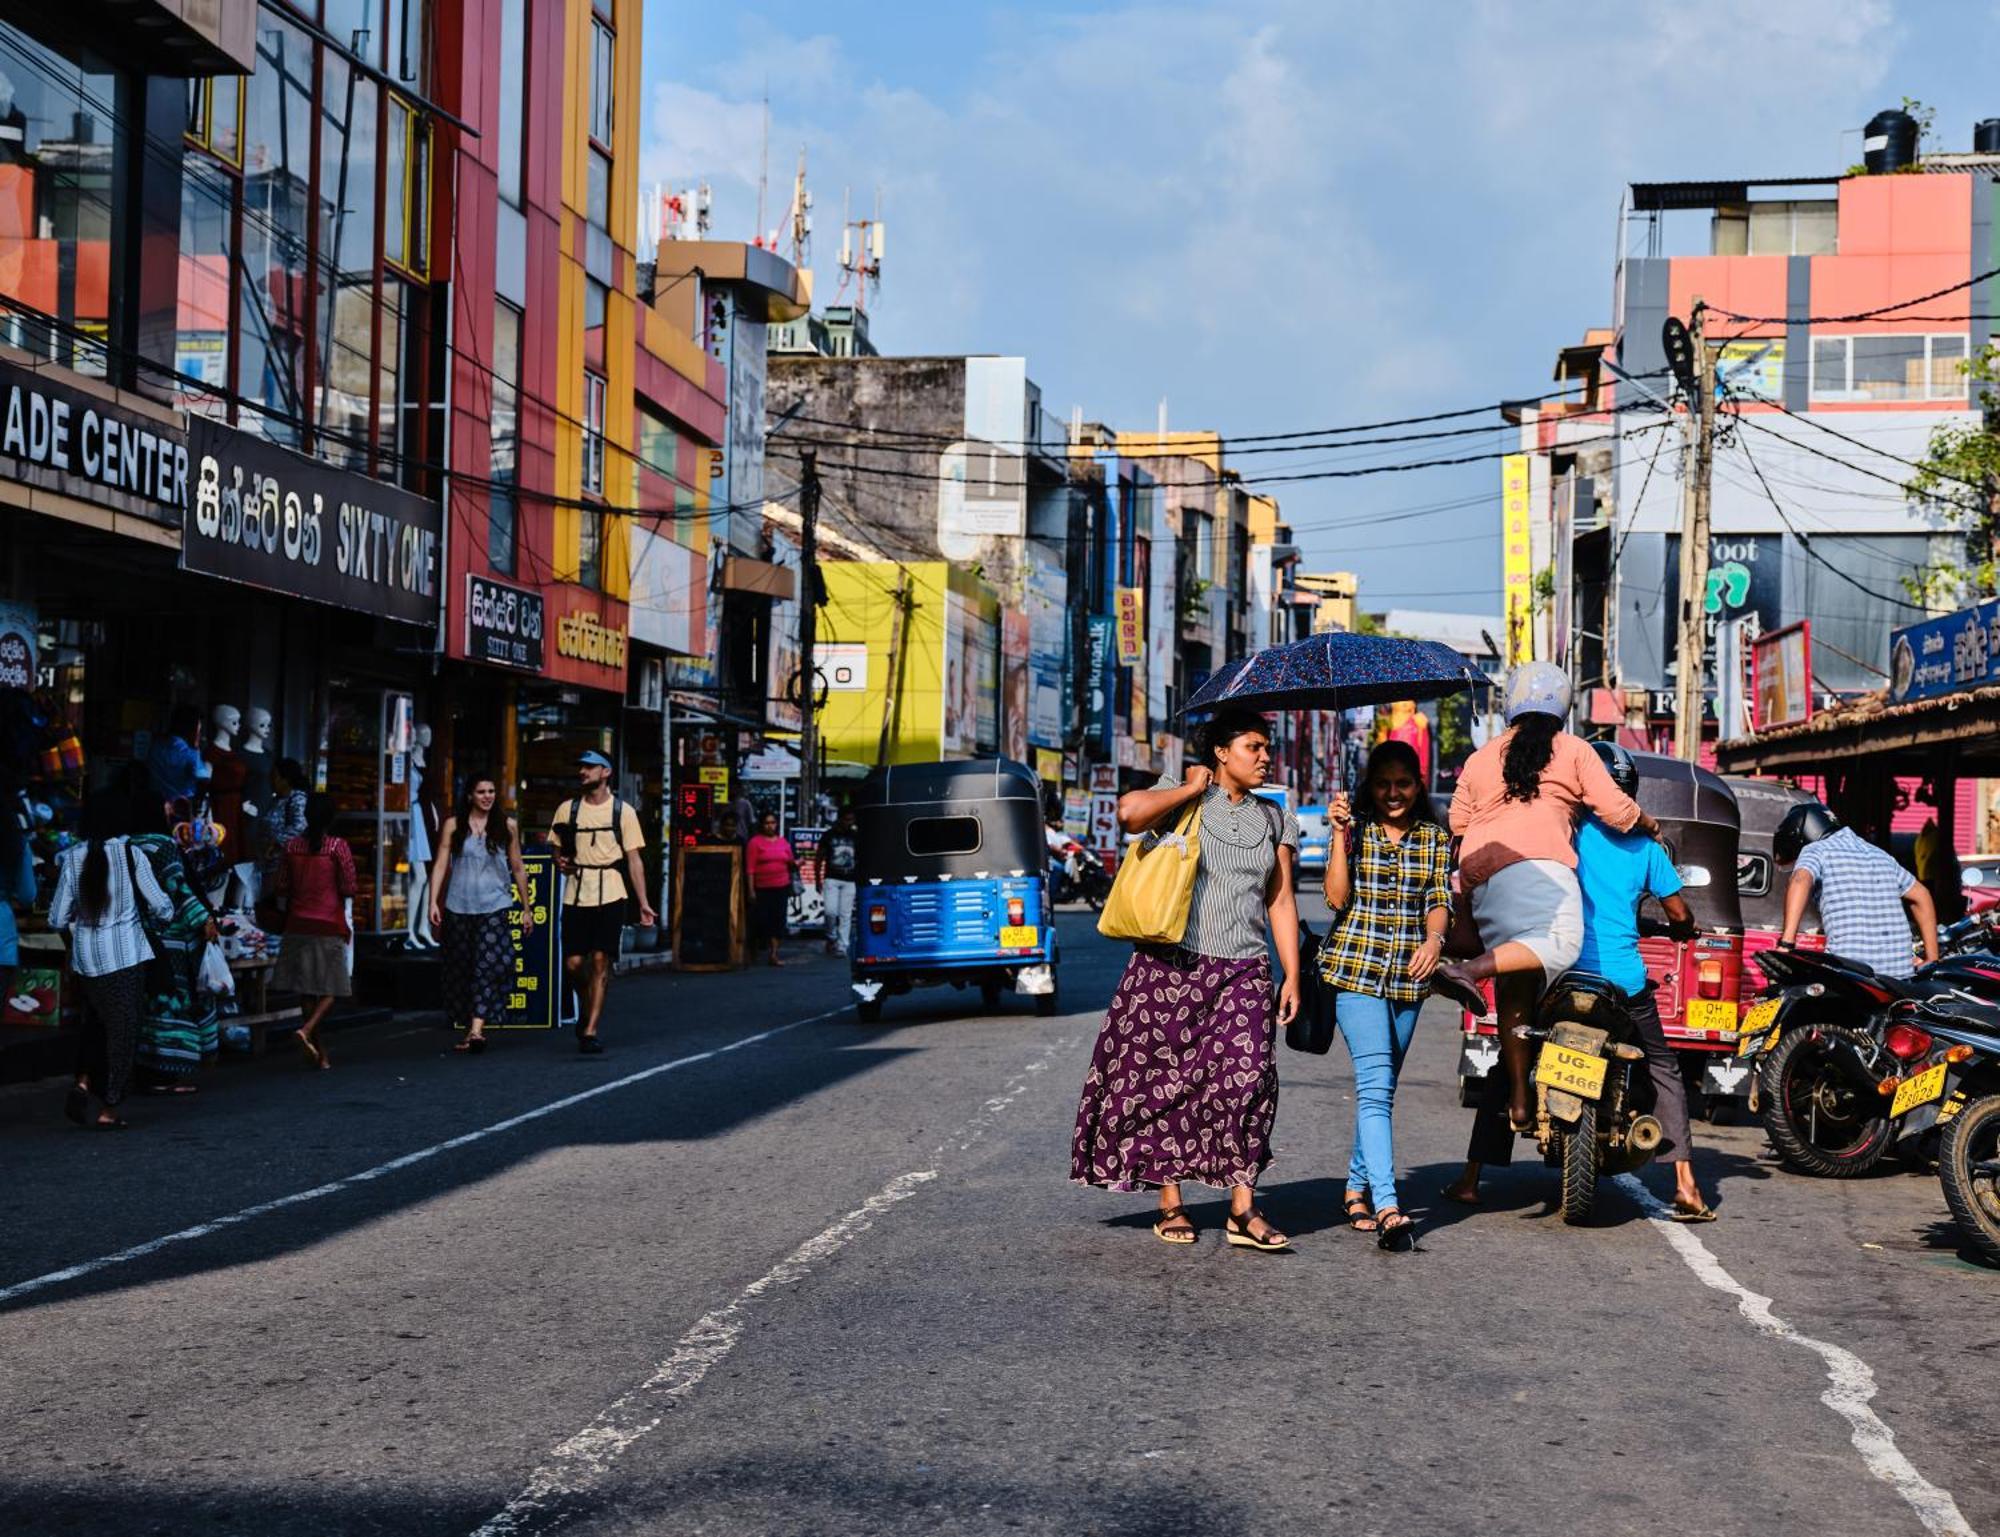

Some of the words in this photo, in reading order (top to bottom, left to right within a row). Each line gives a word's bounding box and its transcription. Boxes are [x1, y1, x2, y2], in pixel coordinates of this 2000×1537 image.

[81, 409, 189, 509] CENTER
[336, 502, 398, 587] SIXTY
[401, 523, 435, 597] ONE
[1710, 536, 1759, 562] oot
[1096, 799, 1115, 848] DSI
[1554, 1071, 1600, 1091] 1466
